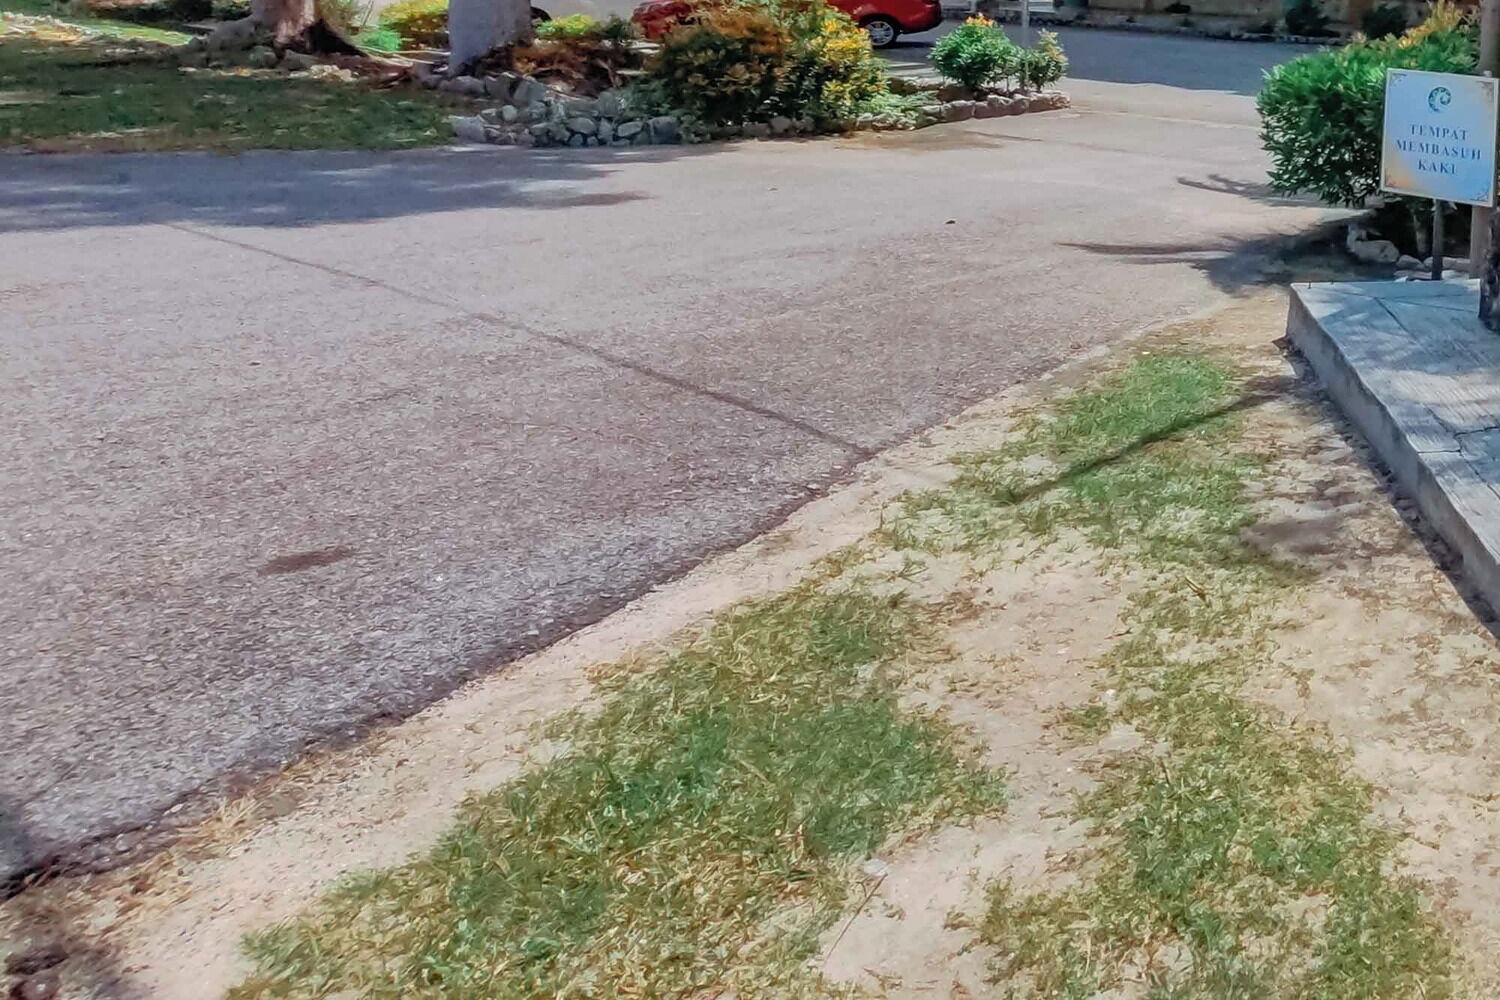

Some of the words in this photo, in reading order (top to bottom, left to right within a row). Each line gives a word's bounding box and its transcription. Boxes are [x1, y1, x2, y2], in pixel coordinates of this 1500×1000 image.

[1409, 123, 1469, 142] TEMPAT
[1394, 139, 1482, 161] MEMBASUH
[1417, 159, 1456, 175] KAKI
